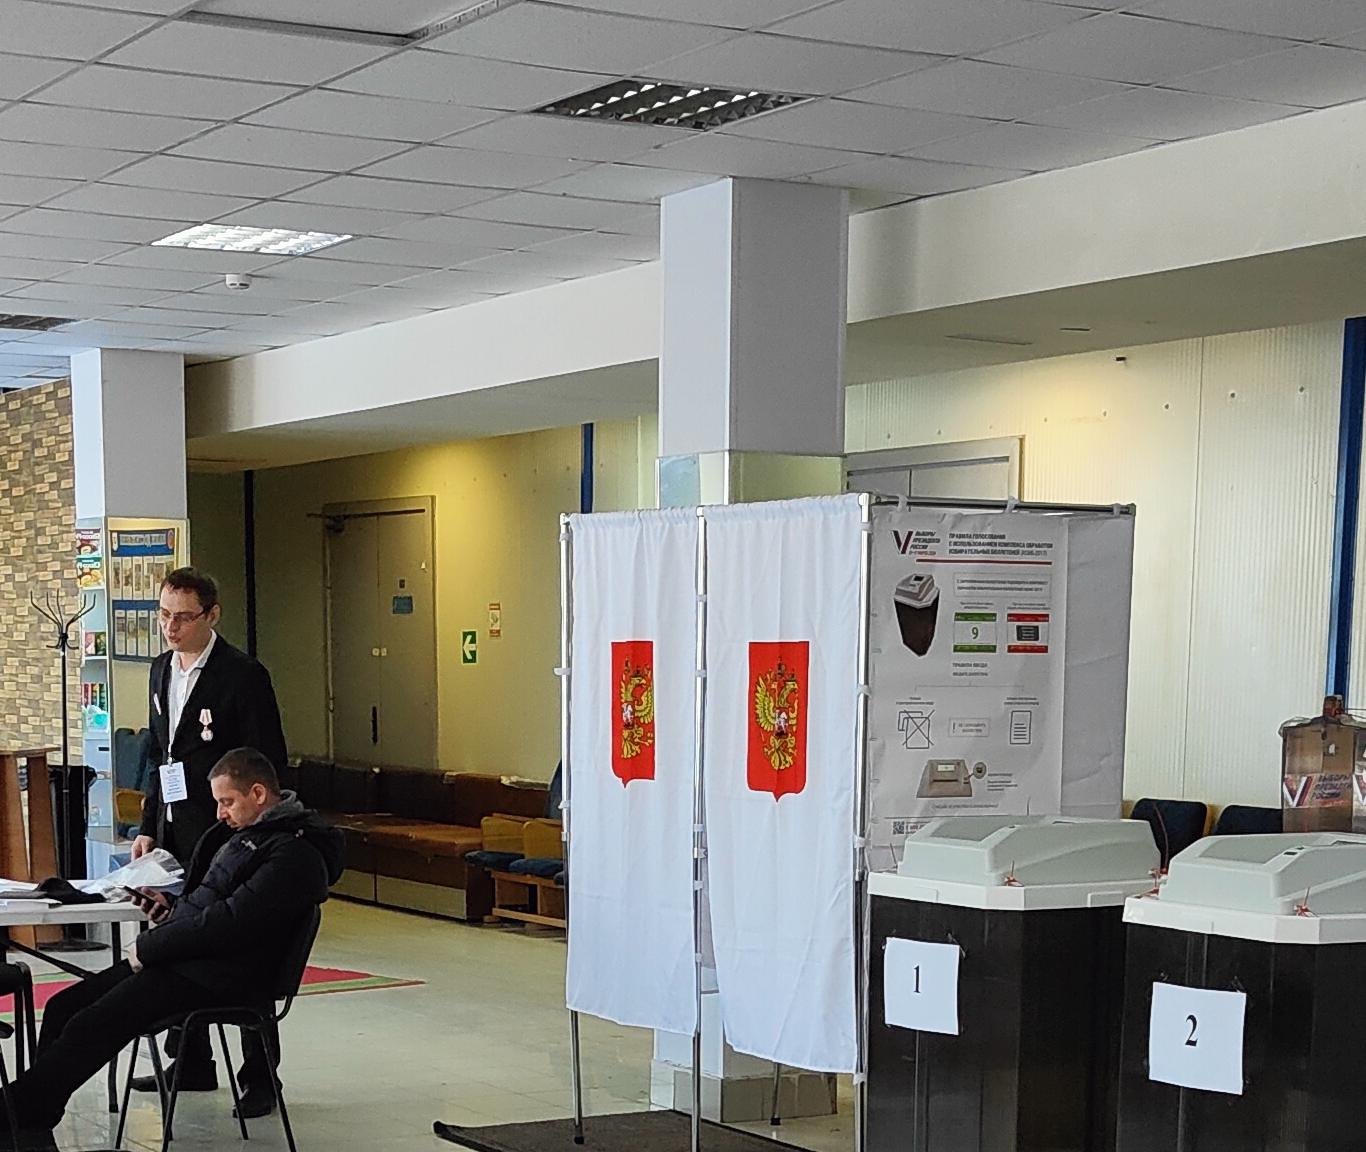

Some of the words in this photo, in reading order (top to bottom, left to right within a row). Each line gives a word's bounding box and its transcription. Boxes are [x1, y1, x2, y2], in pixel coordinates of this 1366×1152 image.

[971, 626, 979, 640] 9
[912, 964, 922, 994] 1
[1184, 1014, 1199, 1047] 2
